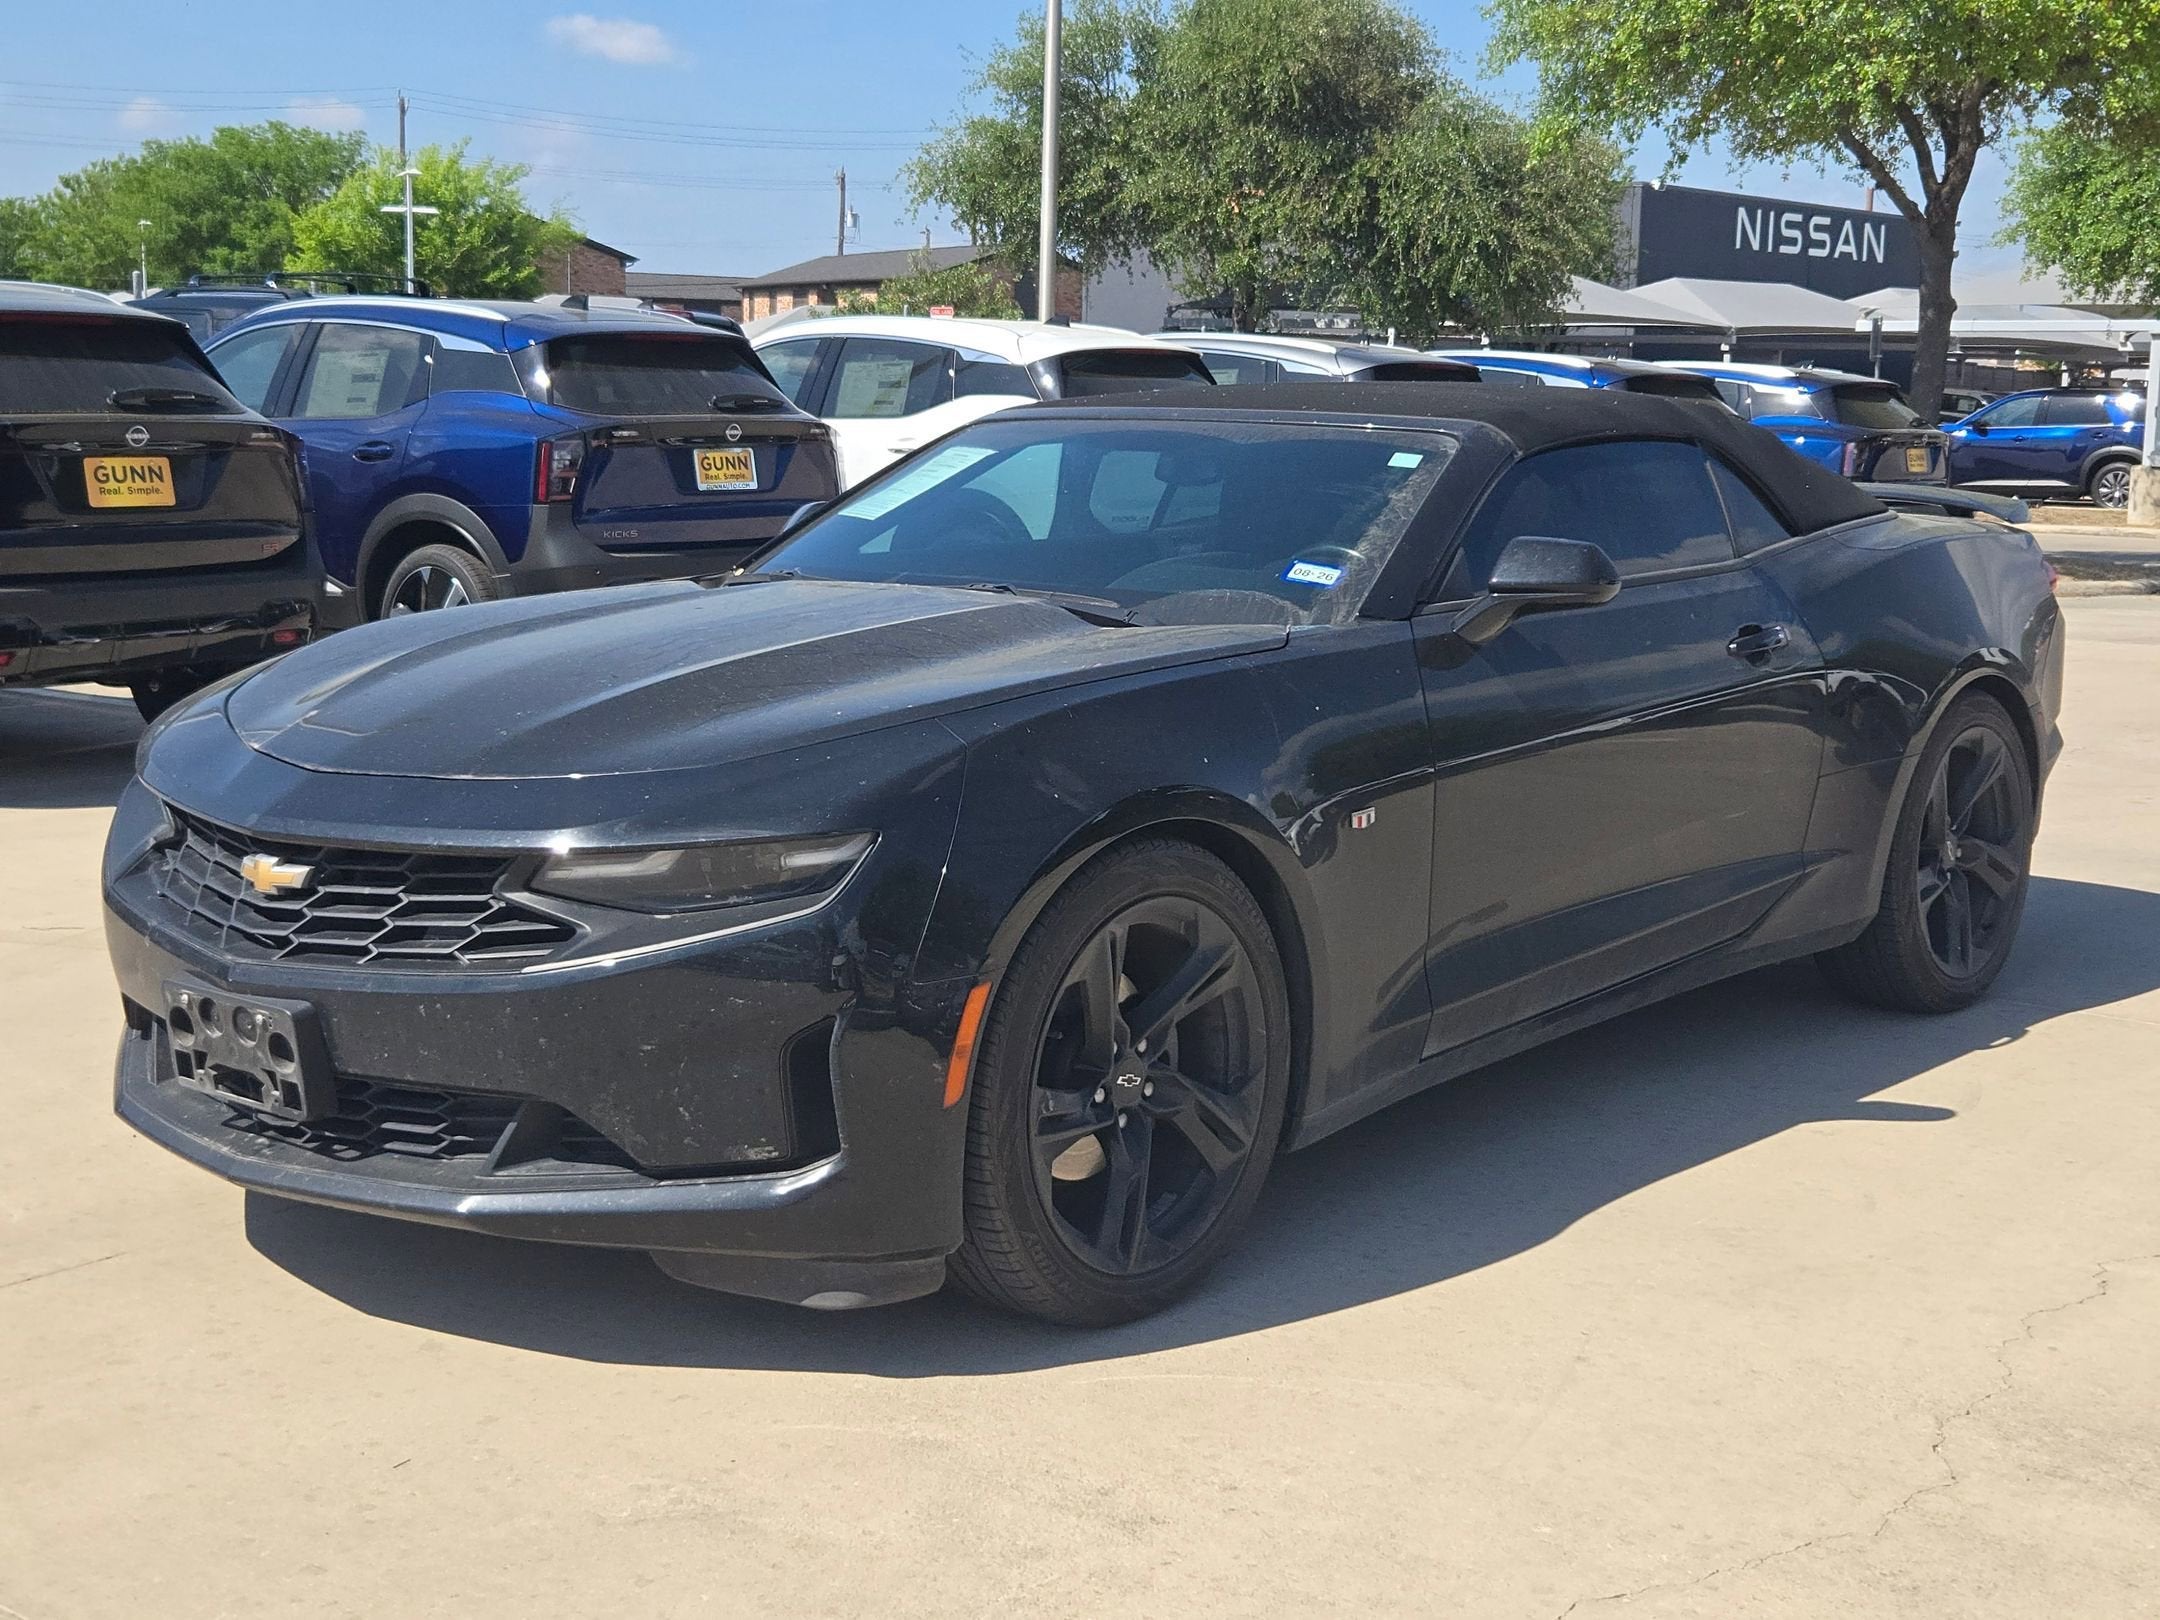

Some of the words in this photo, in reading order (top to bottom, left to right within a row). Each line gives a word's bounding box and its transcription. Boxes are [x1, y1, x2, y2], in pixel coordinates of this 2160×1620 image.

[1735, 206, 1886, 264] NISSAN
[700, 456, 750, 472] GUNN
[93, 465, 165, 485] GUNN
[705, 473, 722, 481] Real.
[99, 486, 124, 496] Real.
[127, 485, 164, 497] Simple.
[603, 530, 639, 538] KICKS
